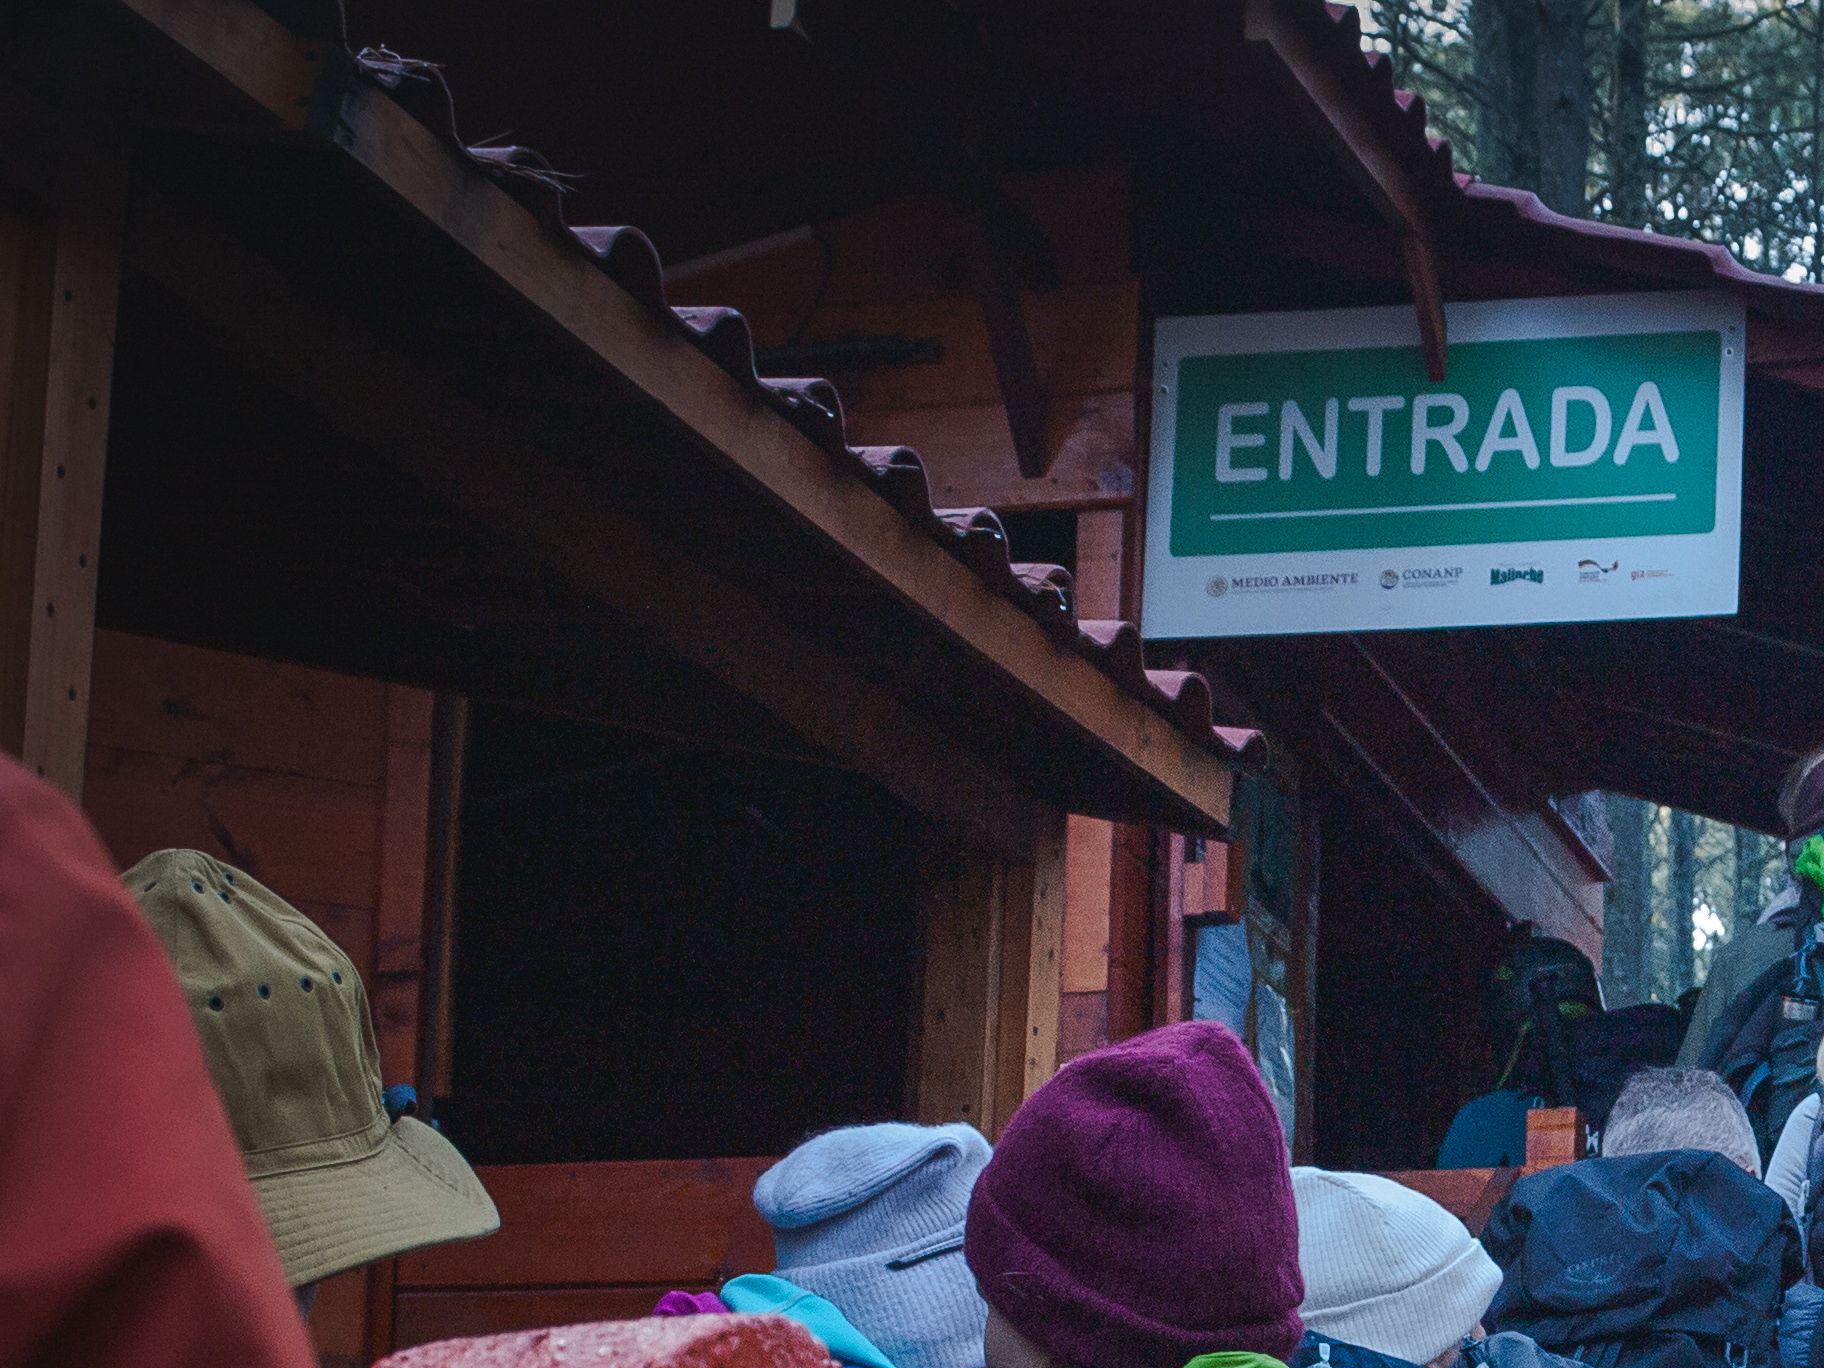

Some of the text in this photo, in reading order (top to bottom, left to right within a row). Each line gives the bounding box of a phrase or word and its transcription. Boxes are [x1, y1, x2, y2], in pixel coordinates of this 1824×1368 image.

[1215, 381, 1680, 483] ENTRADA
[1232, 573, 1359, 588] MEDIO AMBIENTE
[1402, 567, 1463, 580] CONANP
